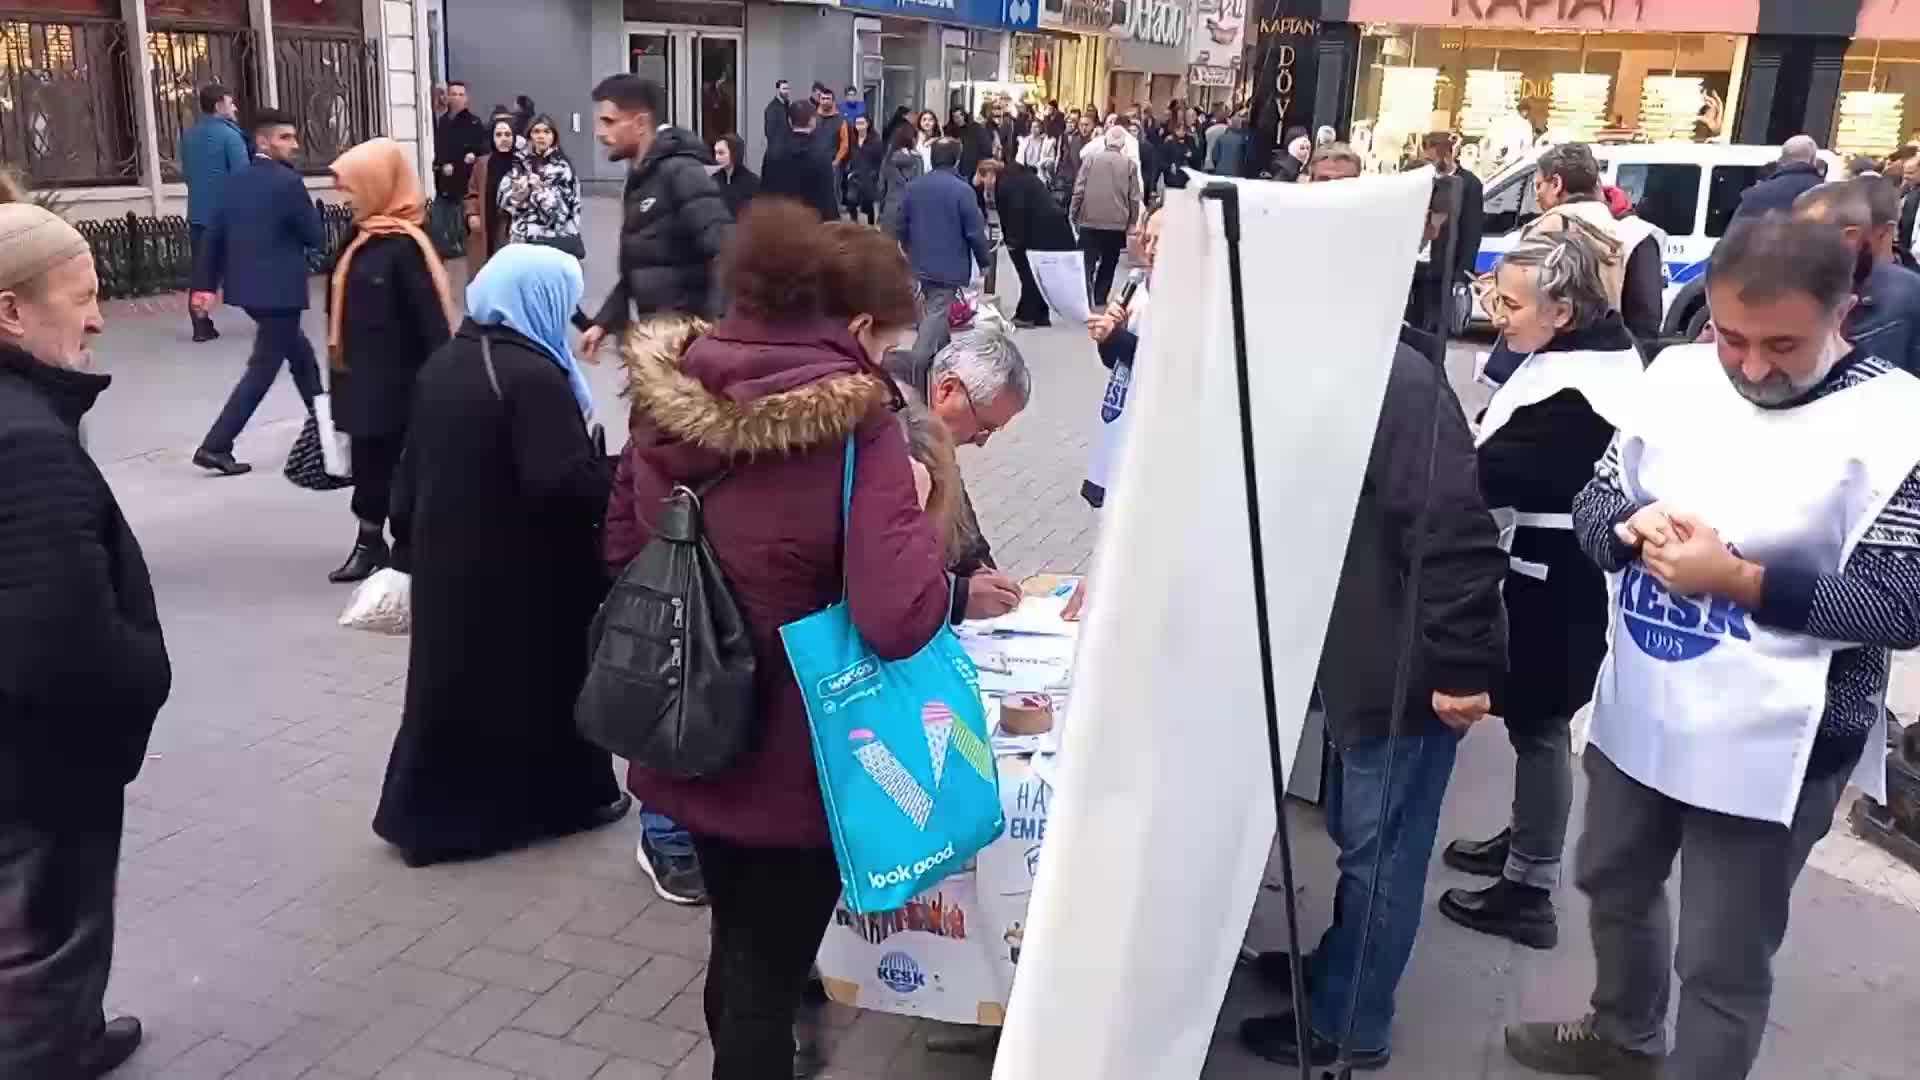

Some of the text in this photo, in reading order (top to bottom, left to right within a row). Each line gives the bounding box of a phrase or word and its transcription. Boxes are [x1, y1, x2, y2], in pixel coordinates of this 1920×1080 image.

[1645, 629, 1685, 657] 1995
[868, 841, 955, 889] look good
[877, 966, 926, 987] KESK
